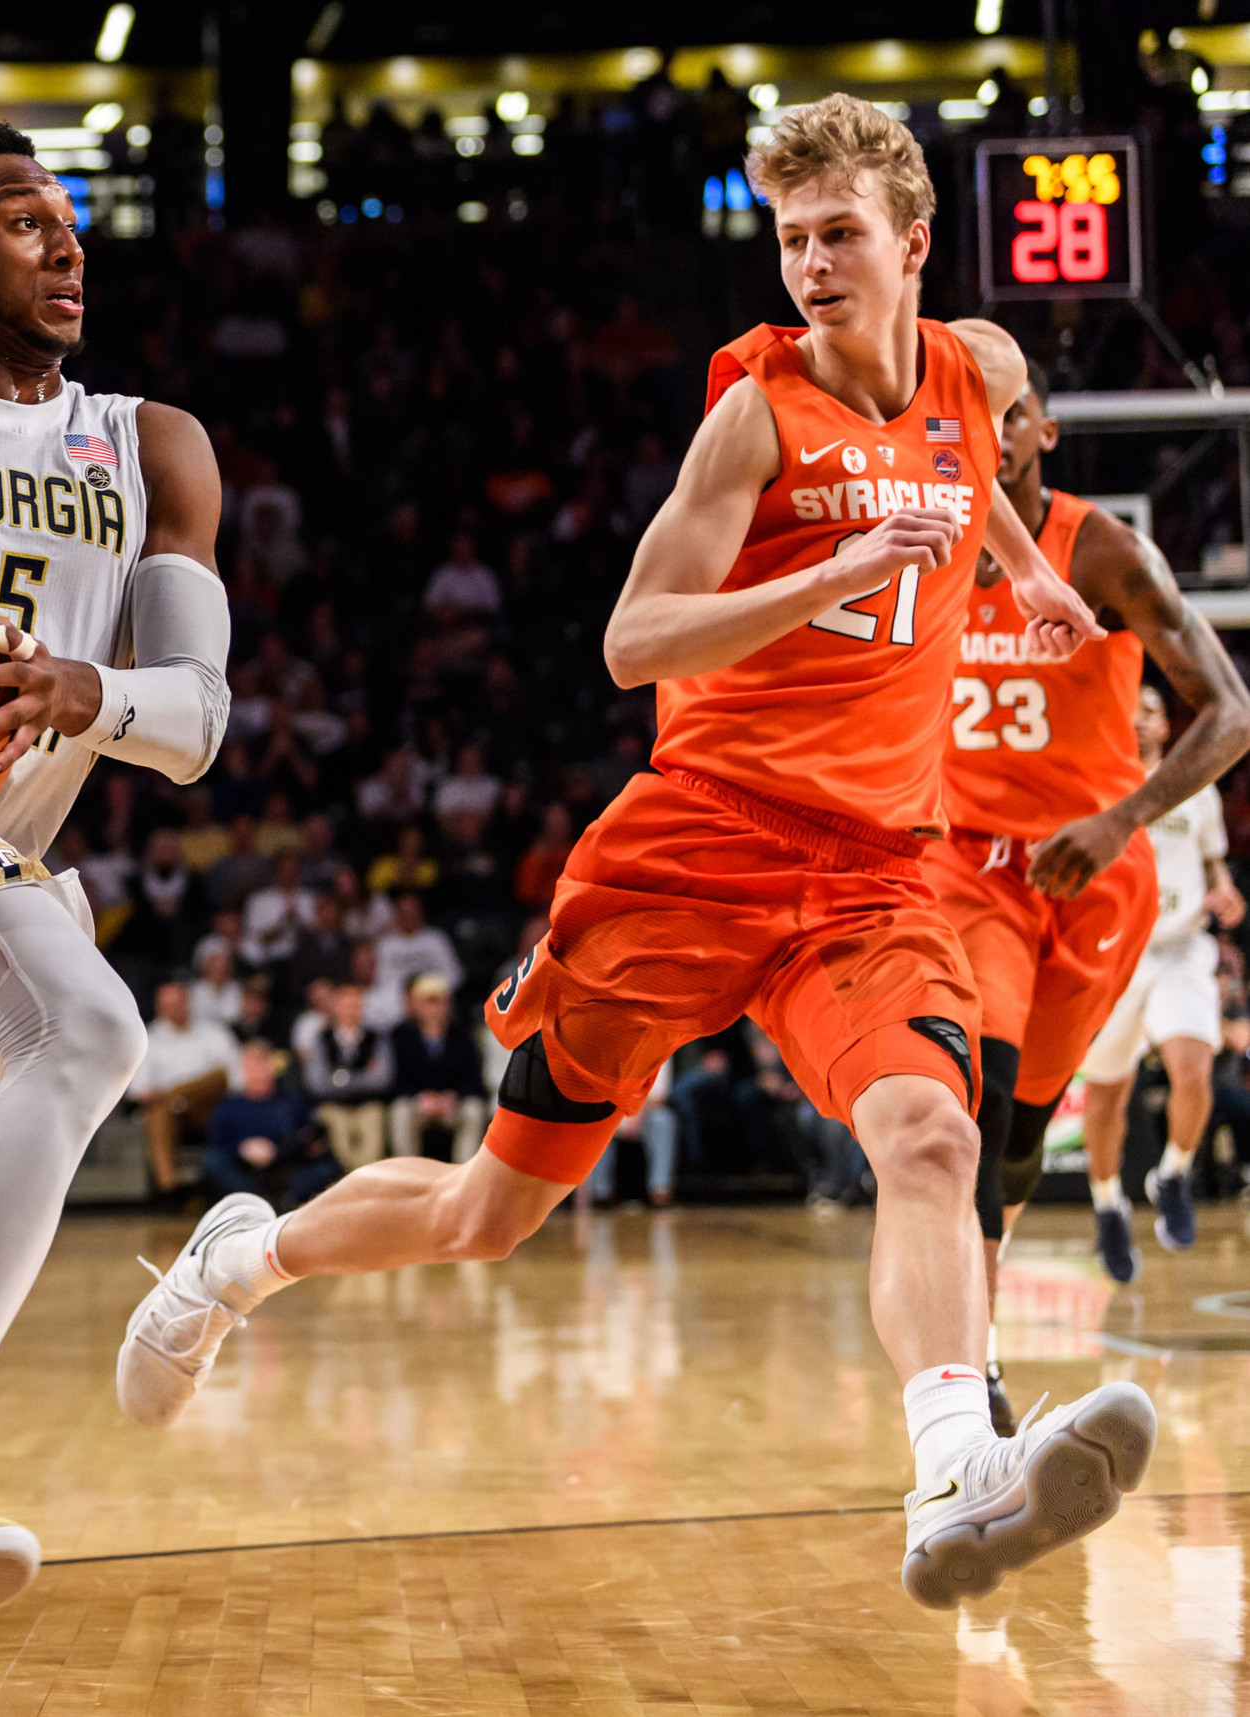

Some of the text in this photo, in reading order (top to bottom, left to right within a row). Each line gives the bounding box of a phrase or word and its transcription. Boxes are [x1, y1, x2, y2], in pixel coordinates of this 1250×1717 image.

[1012, 201, 1109, 283] 28
[790, 478, 974, 526] SYRACUSE
[952, 676, 1051, 752] 23
